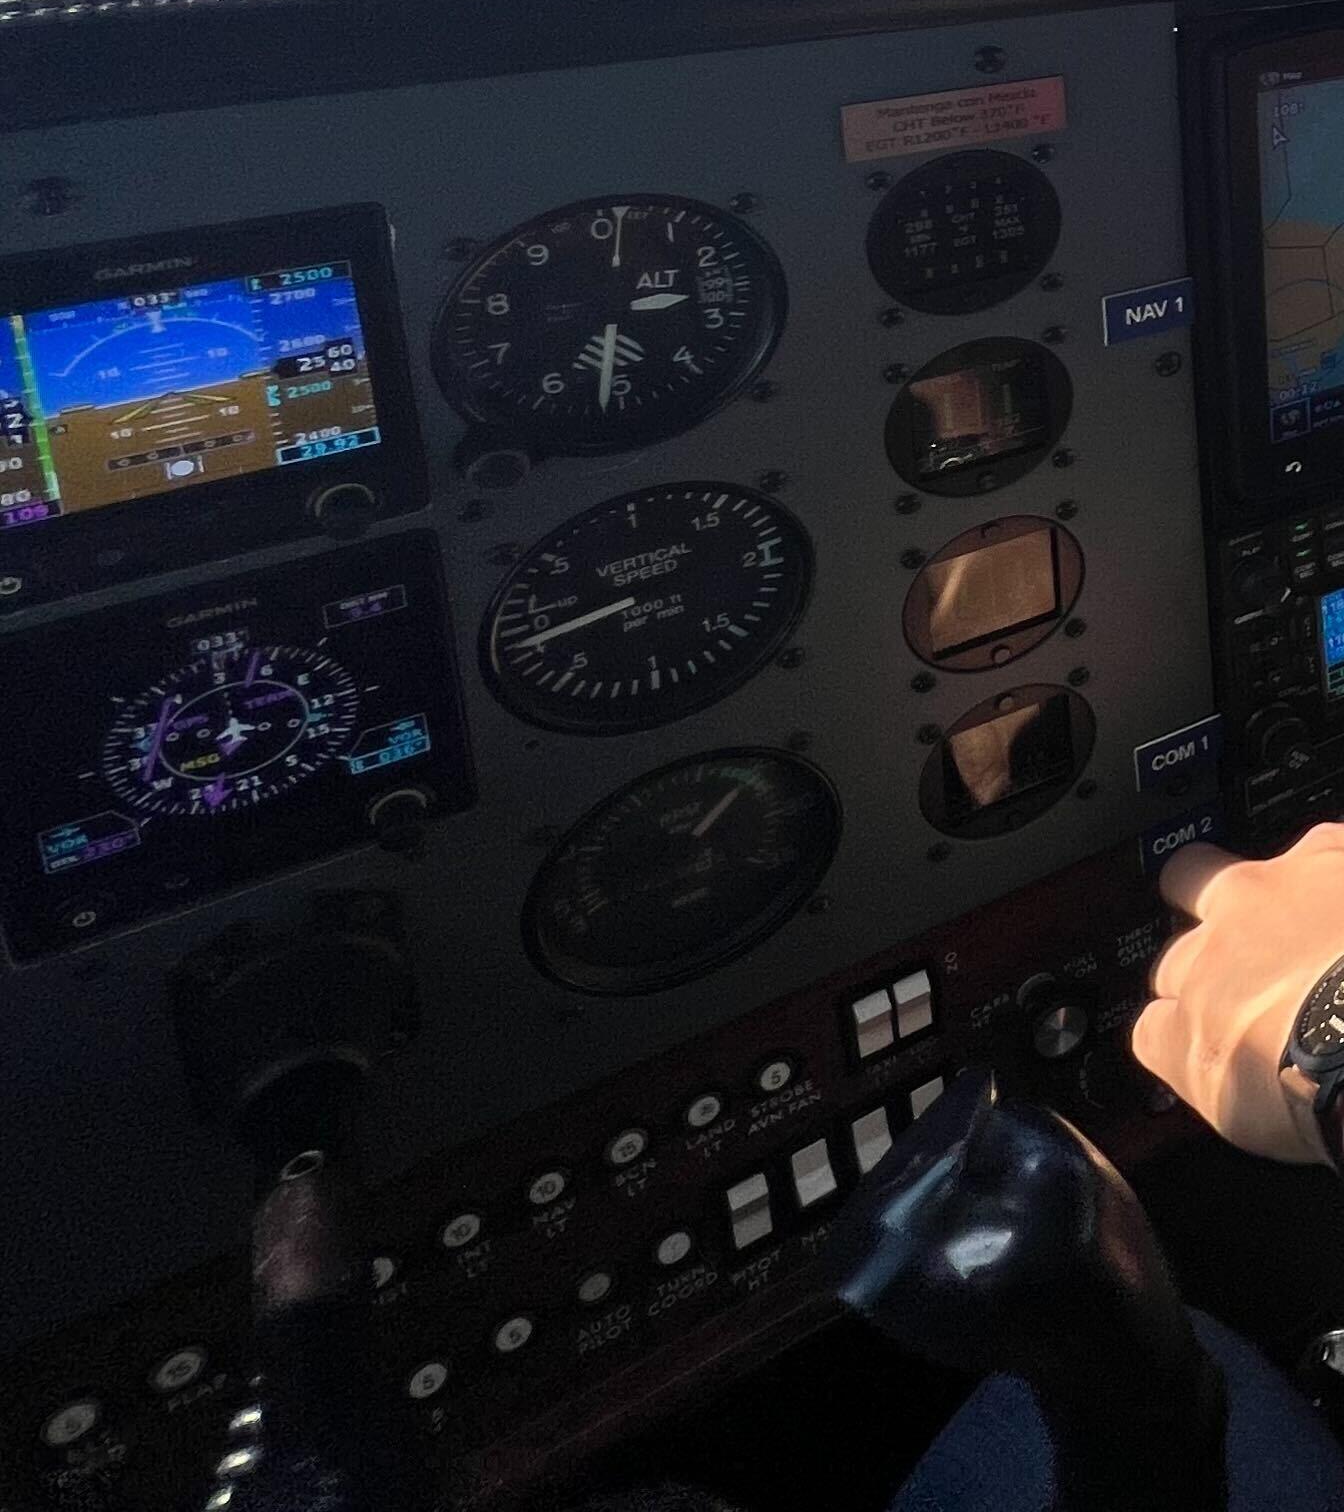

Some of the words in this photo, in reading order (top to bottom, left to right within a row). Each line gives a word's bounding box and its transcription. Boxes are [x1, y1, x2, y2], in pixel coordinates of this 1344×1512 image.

[590, 217, 613, 240] 0
[666, 221, 675, 244] 1
[526, 244, 549, 266] 9
[696, 245, 721, 268] 2
[94, 256, 193, 282] GARMIN
[279, 266, 333, 286] 2500
[634, 268, 681, 291] ALT
[486, 292, 511, 316] 8
[1125, 299, 1169, 327] NAV
[1175, 295, 1186, 314] 1
[703, 307, 724, 330] 3
[487, 341, 512, 366] 7
[672, 345, 696, 364] 4
[542, 372, 566, 395] 6
[612, 373, 632, 397] 5
[627, 513, 638, 529] 1
[691, 511, 721, 532] 1.5
[595, 542, 693, 578] VERTICAL
[612, 558, 679, 588] SPEED
[621, 598, 665, 619] 1000
[623, 616, 648, 633] per
[656, 603, 685, 620] min
[533, 614, 551, 631] 0
[702, 612, 731, 634] 1.5
[310, 693, 335, 710] 12
[1151, 740, 1196, 772] COM
[1200, 734, 1210, 752] 1
[1152, 822, 1197, 856] COM
[1199, 815, 1214, 835] 2
[750, 1078, 815, 1119] STROBE
[747, 1109, 785, 1137] AVN
[788, 1089, 822, 1116] FAN
[685, 1118, 737, 1151] LAND
[704, 1139, 722, 1158] LT
[626, 1176, 648, 1197] LT
[729, 1248, 782, 1288] PITOT
[655, 1265, 706, 1298] TURN
[747, 1270, 770, 1292] HT
[647, 1271, 719, 1316] COORD
[576, 1303, 632, 1344] AUTO
[577, 1316, 633, 1356] PILOT
